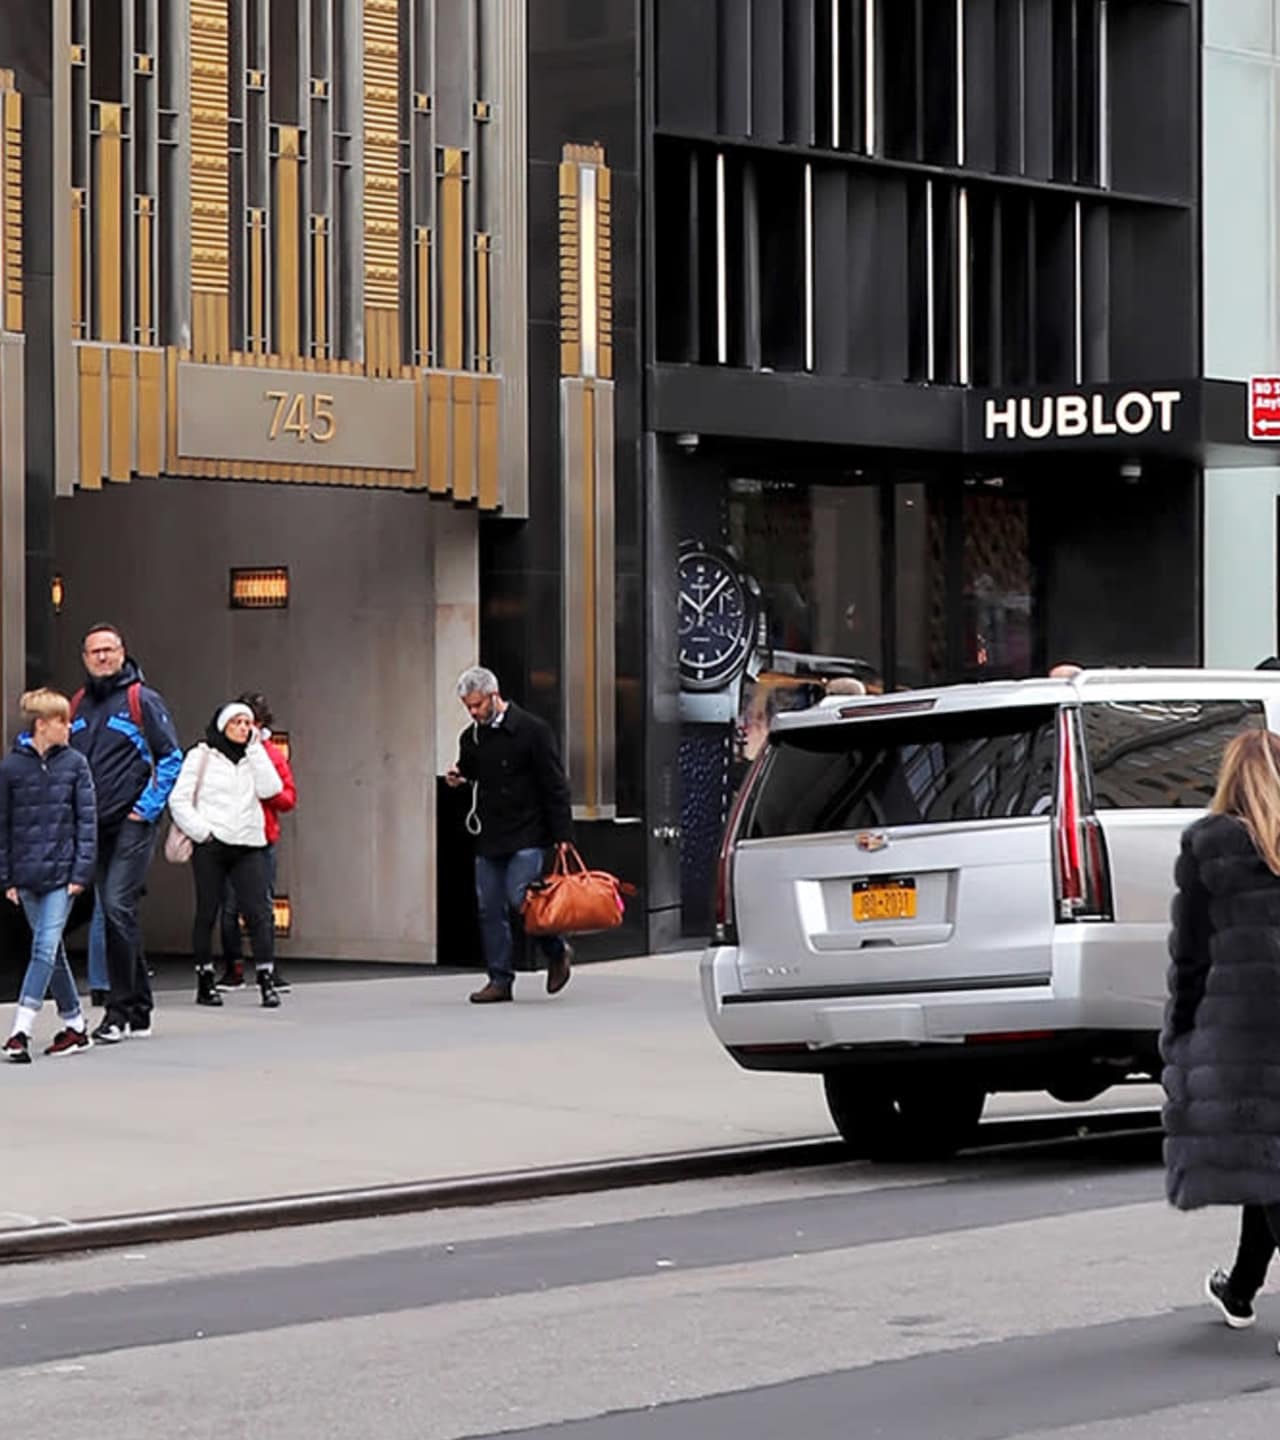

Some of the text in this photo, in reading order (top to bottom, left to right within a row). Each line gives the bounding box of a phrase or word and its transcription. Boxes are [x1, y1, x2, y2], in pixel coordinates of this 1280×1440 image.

[1254, 381, 1272, 395] NO
[263, 391, 337, 443] 745
[984, 390, 1182, 440] HUBLOT
